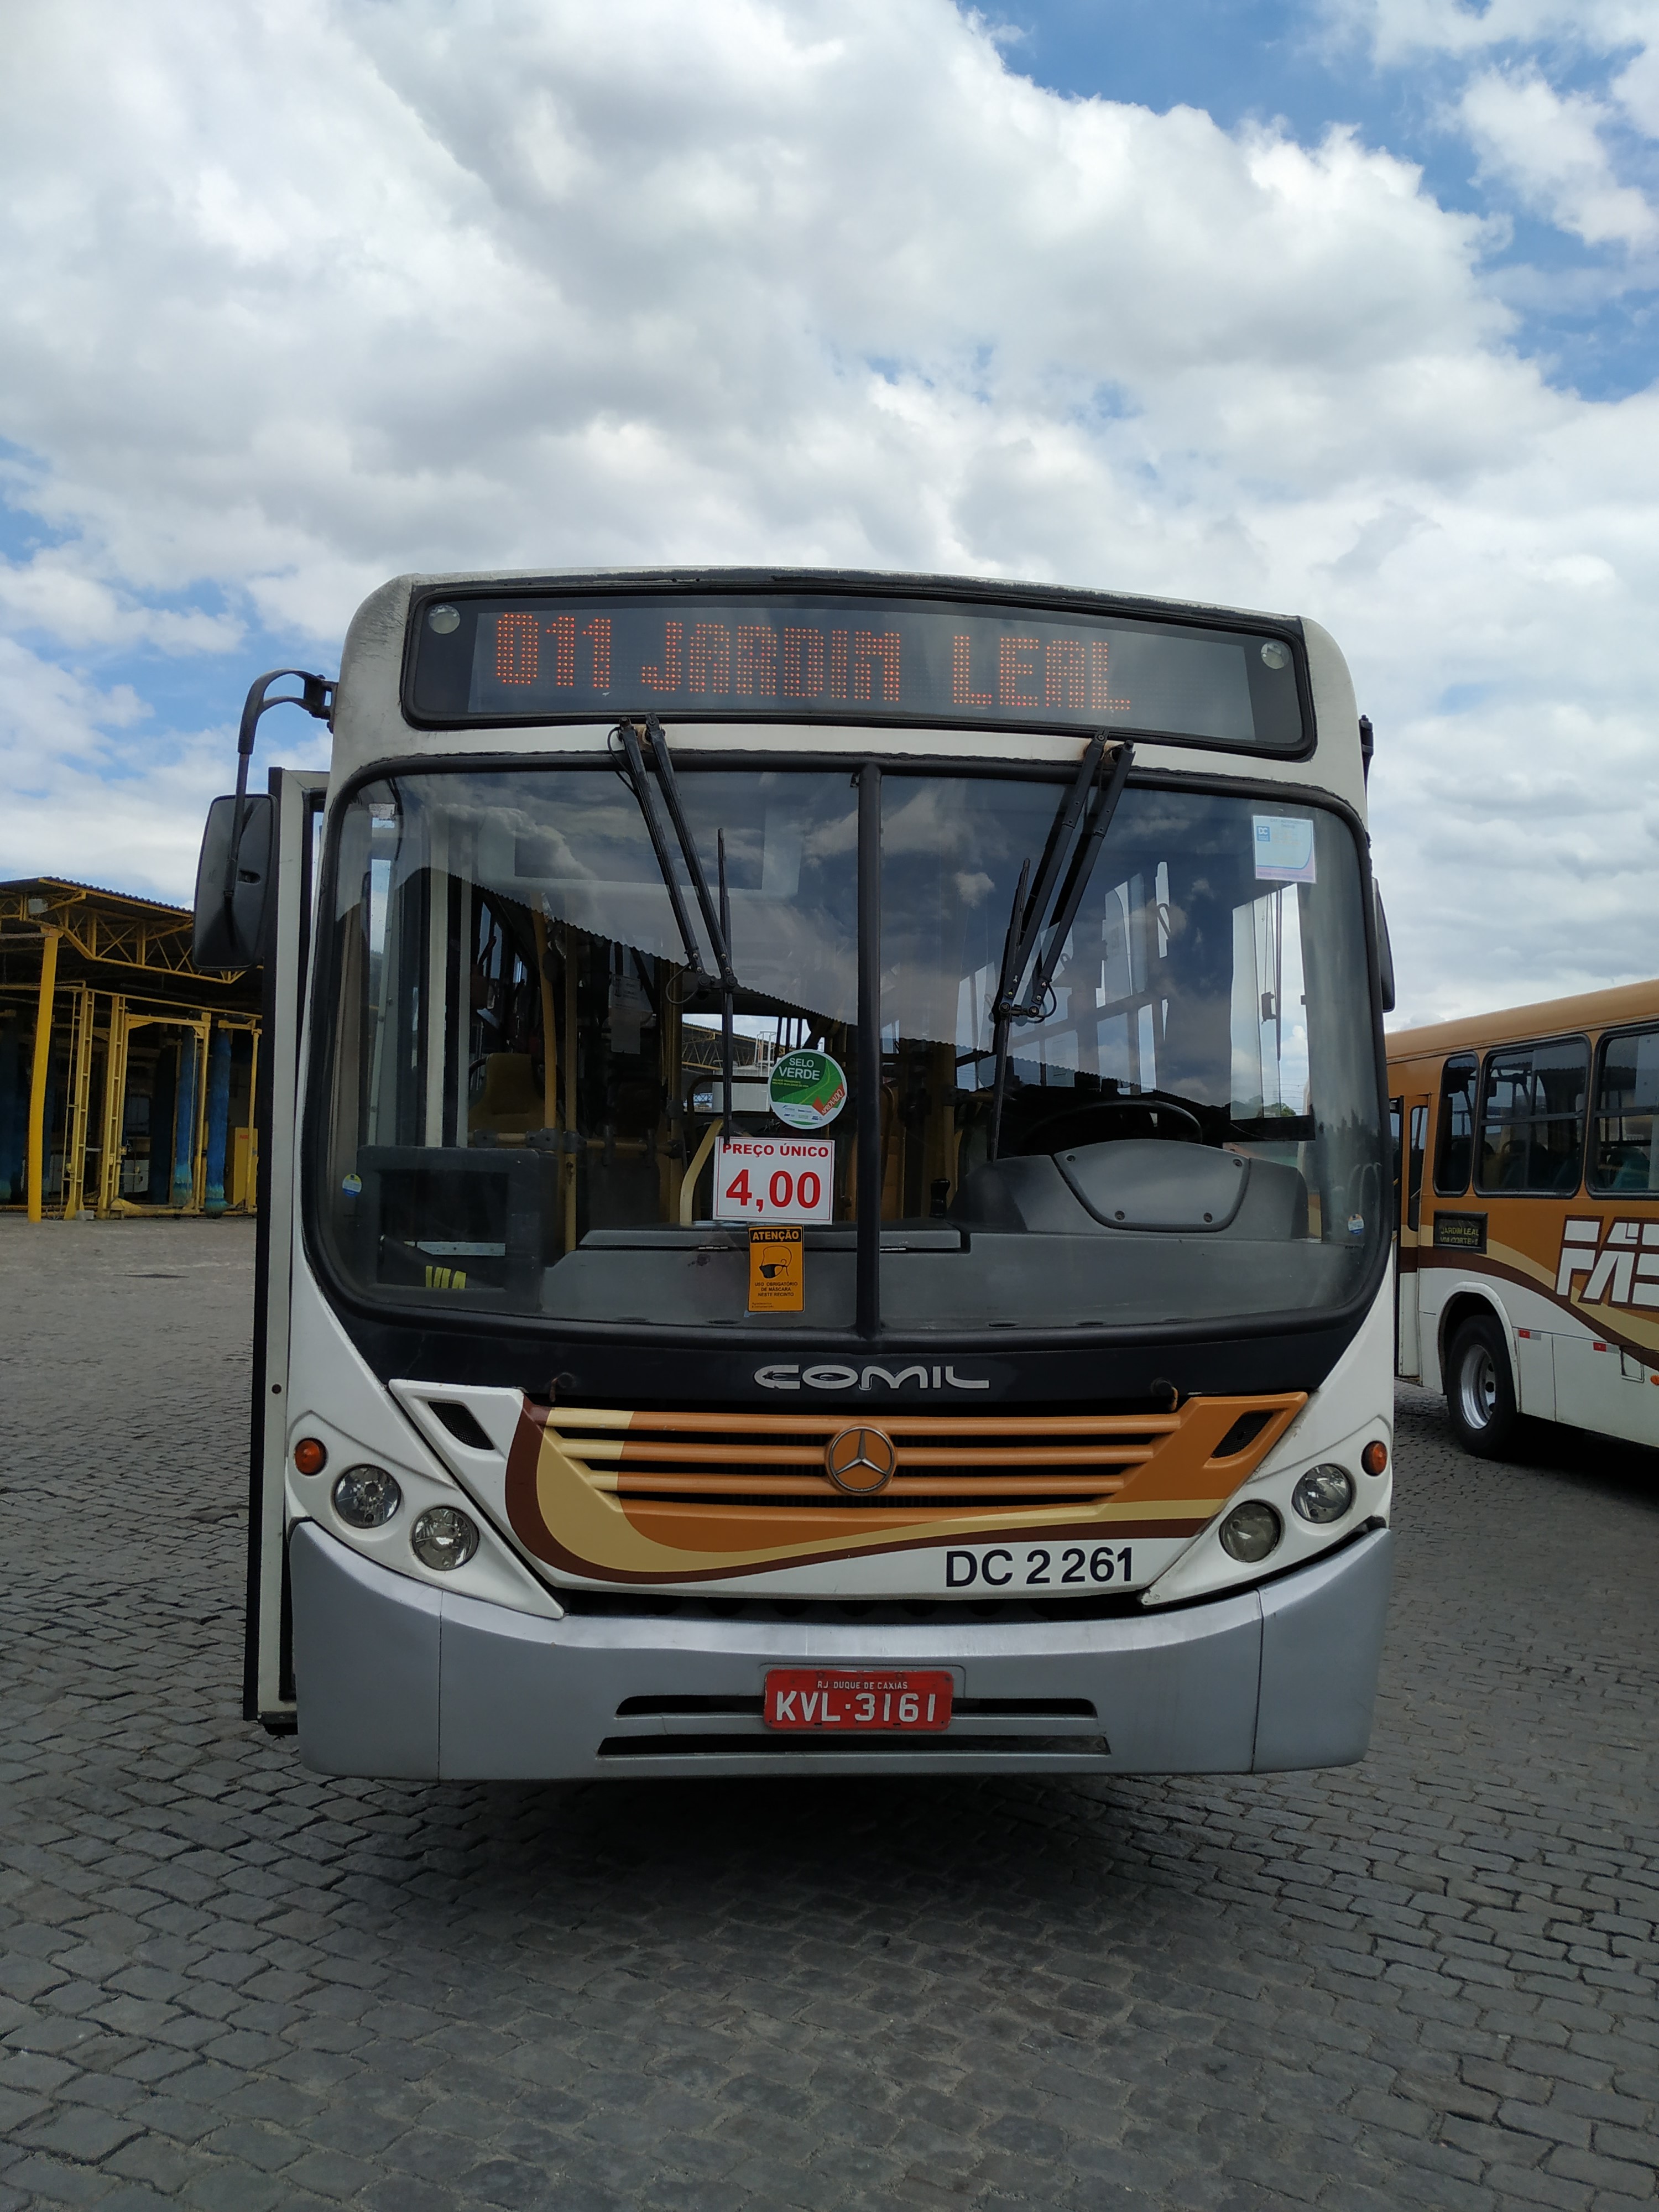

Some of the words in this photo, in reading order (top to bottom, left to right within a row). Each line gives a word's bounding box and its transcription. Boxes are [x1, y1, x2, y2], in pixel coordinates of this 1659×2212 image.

[497, 613, 611, 689] 011
[641, 621, 901, 701] JARDIM
[953, 635, 1131, 710] LEAL
[1258, 827, 1269, 835] DC
[789, 1057, 815, 1068] SELO
[779, 1066, 821, 1081] VERDE
[821, 1088, 843, 1115] APROVADO
[723, 1143, 774, 1157] PREÇO
[780, 1142, 829, 1157] ÚNICO
[726, 1168, 821, 1213] 4,00
[752, 1229, 799, 1242] ATENÇÃO
[1463, 1228, 1479, 1237] LEAL
[754, 1364, 989, 1390] COMIL
[946, 1549, 1013, 1588] DC
[817, 1681, 828, 1689] RJ
[833, 1681, 861, 1689] DUQUE
[864, 1682, 874, 1690] DE
[877, 1681, 908, 1690] CAXIAS
